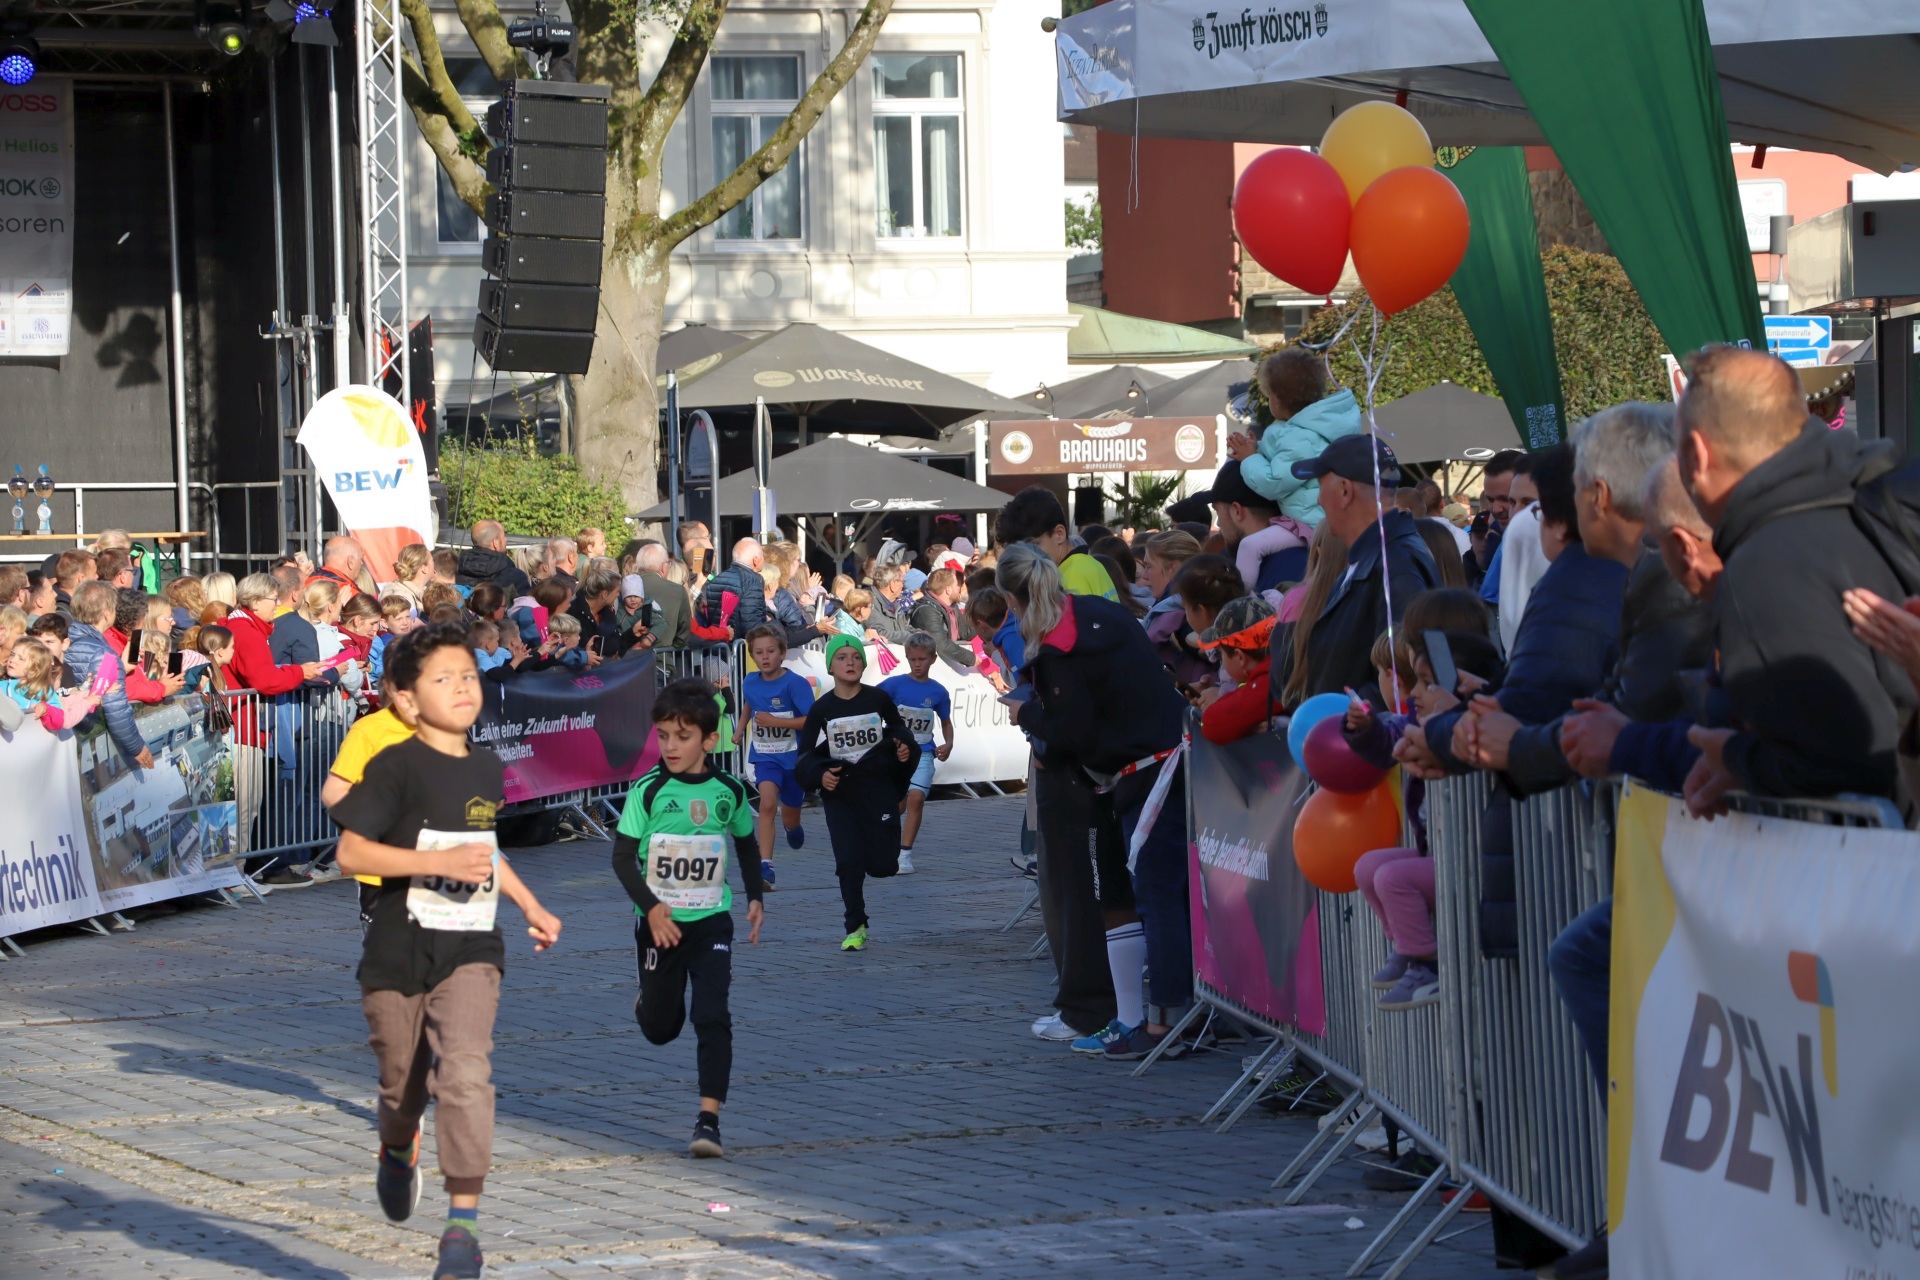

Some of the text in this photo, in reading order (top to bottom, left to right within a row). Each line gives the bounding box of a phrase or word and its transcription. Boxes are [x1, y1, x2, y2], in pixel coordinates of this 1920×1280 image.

[1206, 8, 1311, 59] Zunft KÖLSCH
[5, 138, 59, 153] Helios
[1766, 328, 1812, 337] Einbahnstraße
[796, 367, 925, 391] Warsteiner
[1060, 439, 1147, 463] BRAUHAUS
[335, 467, 403, 492] BEW
[571, 675, 605, 690] VOSS
[953, 684, 1010, 728] Für u
[501, 719, 523, 739] eine
[524, 714, 570, 736] Zukunft
[570, 711, 596, 730] voller
[901, 716, 931, 732] 137
[834, 727, 878, 749] 5586
[656, 856, 719, 882] 5097
[645, 947, 658, 971] JD
[1660, 990, 1830, 1217] BEW
